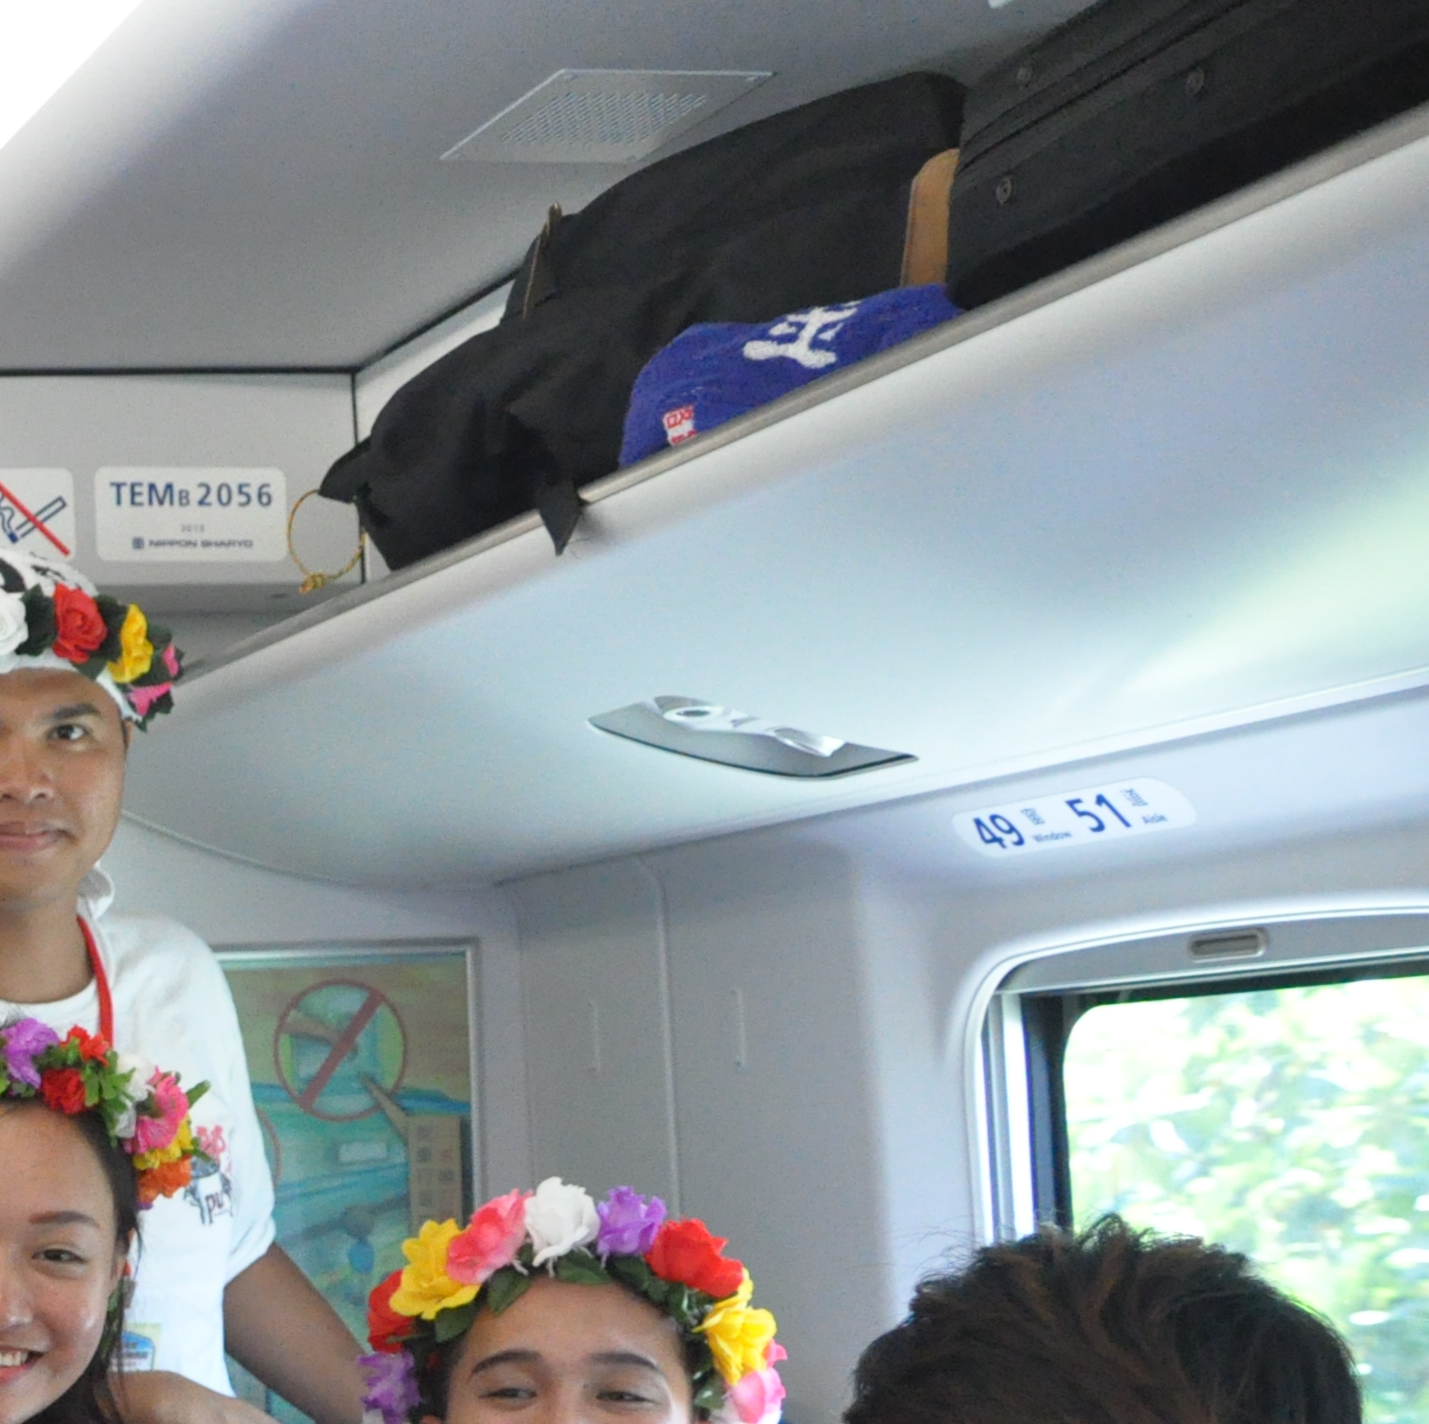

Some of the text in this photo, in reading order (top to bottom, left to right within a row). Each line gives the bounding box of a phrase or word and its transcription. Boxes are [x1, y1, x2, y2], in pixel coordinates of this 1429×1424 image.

[197, 482, 273, 507] 2056
[148, 538, 198, 548] NIPPON
[972, 813, 1025, 849] 49
[1065, 793, 1132, 833] 51
[1030, 813, 1168, 844] Window Aisle
